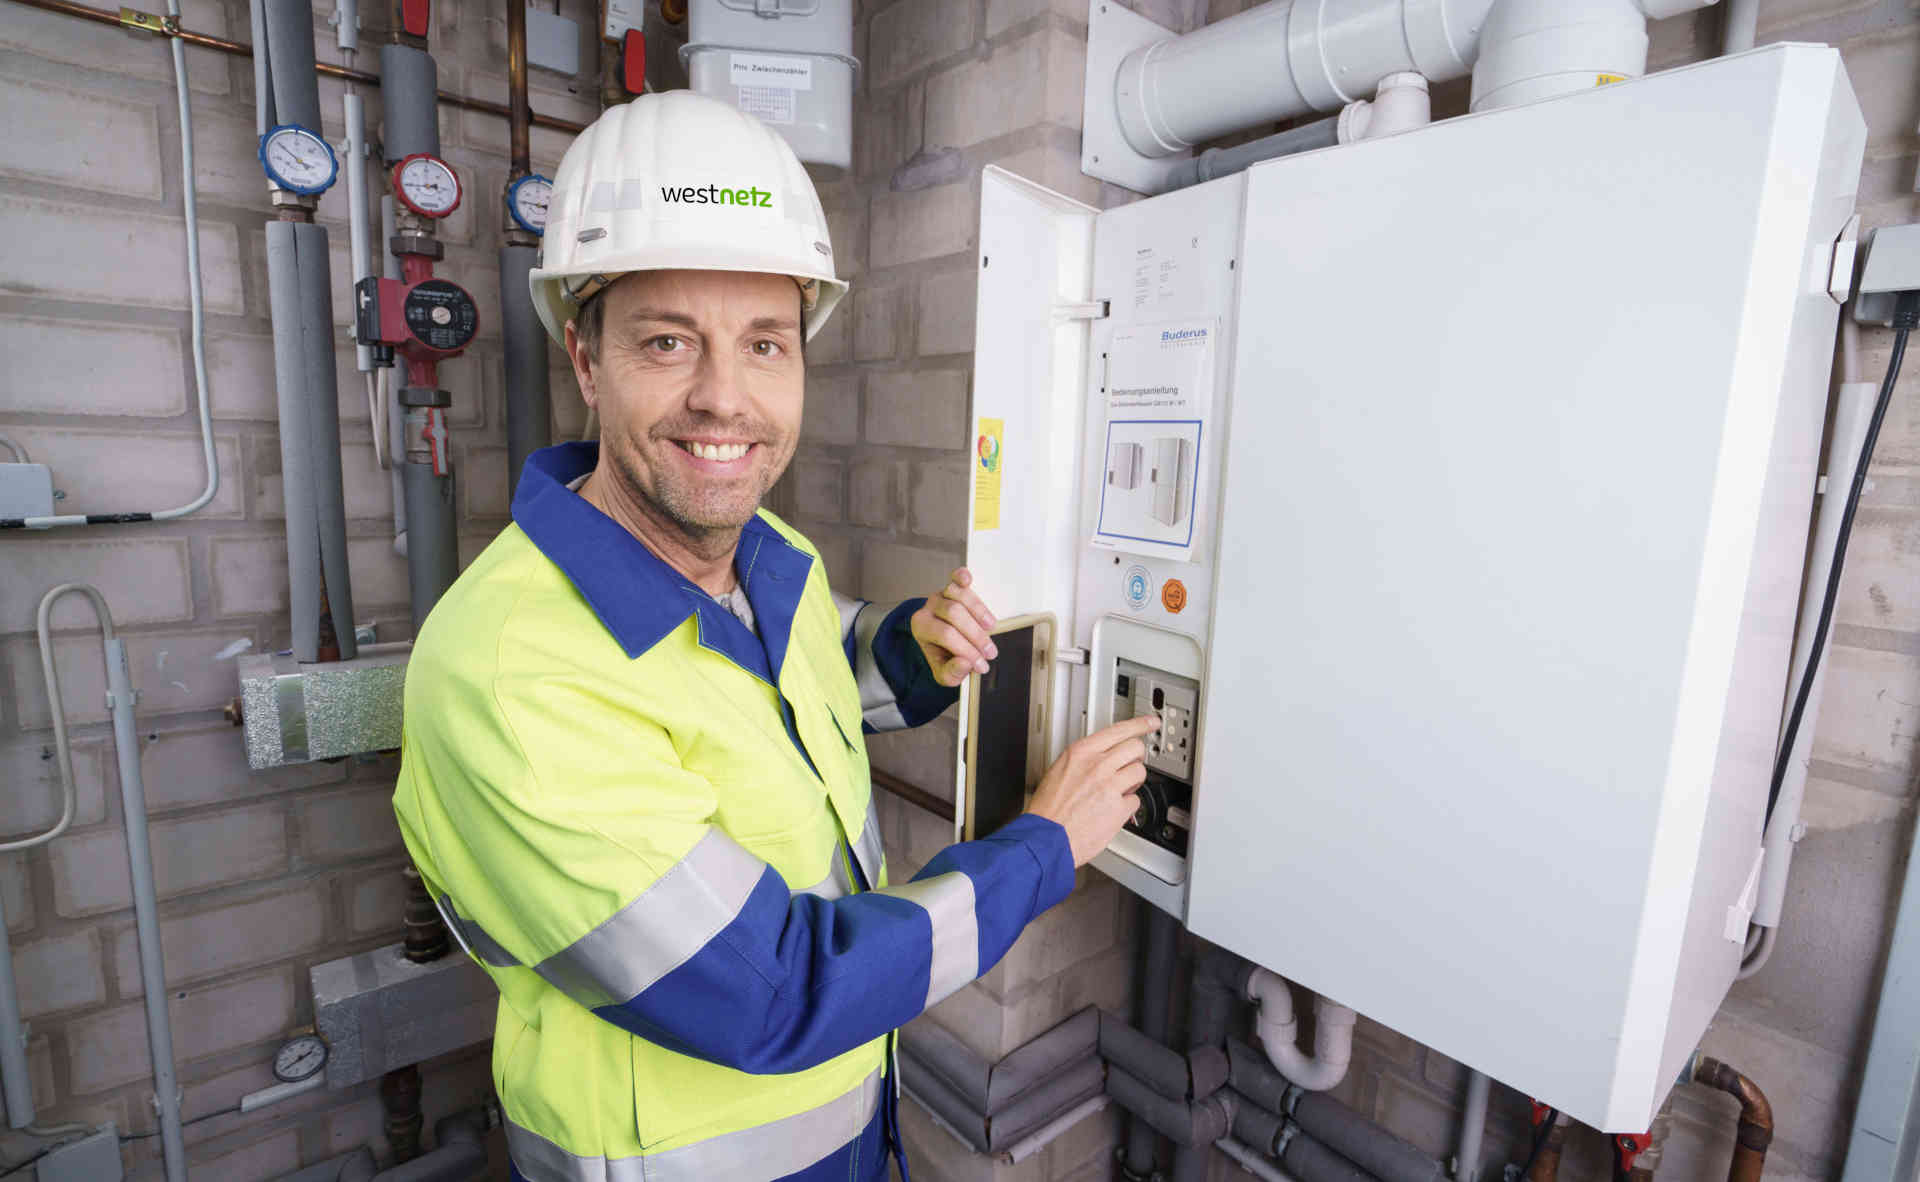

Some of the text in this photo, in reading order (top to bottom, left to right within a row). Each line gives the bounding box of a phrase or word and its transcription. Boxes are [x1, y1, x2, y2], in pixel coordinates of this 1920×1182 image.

[661, 184, 773, 207] westnetz
[1160, 328, 1208, 341] Buderus
[1111, 386, 1179, 397] gsanleitung
